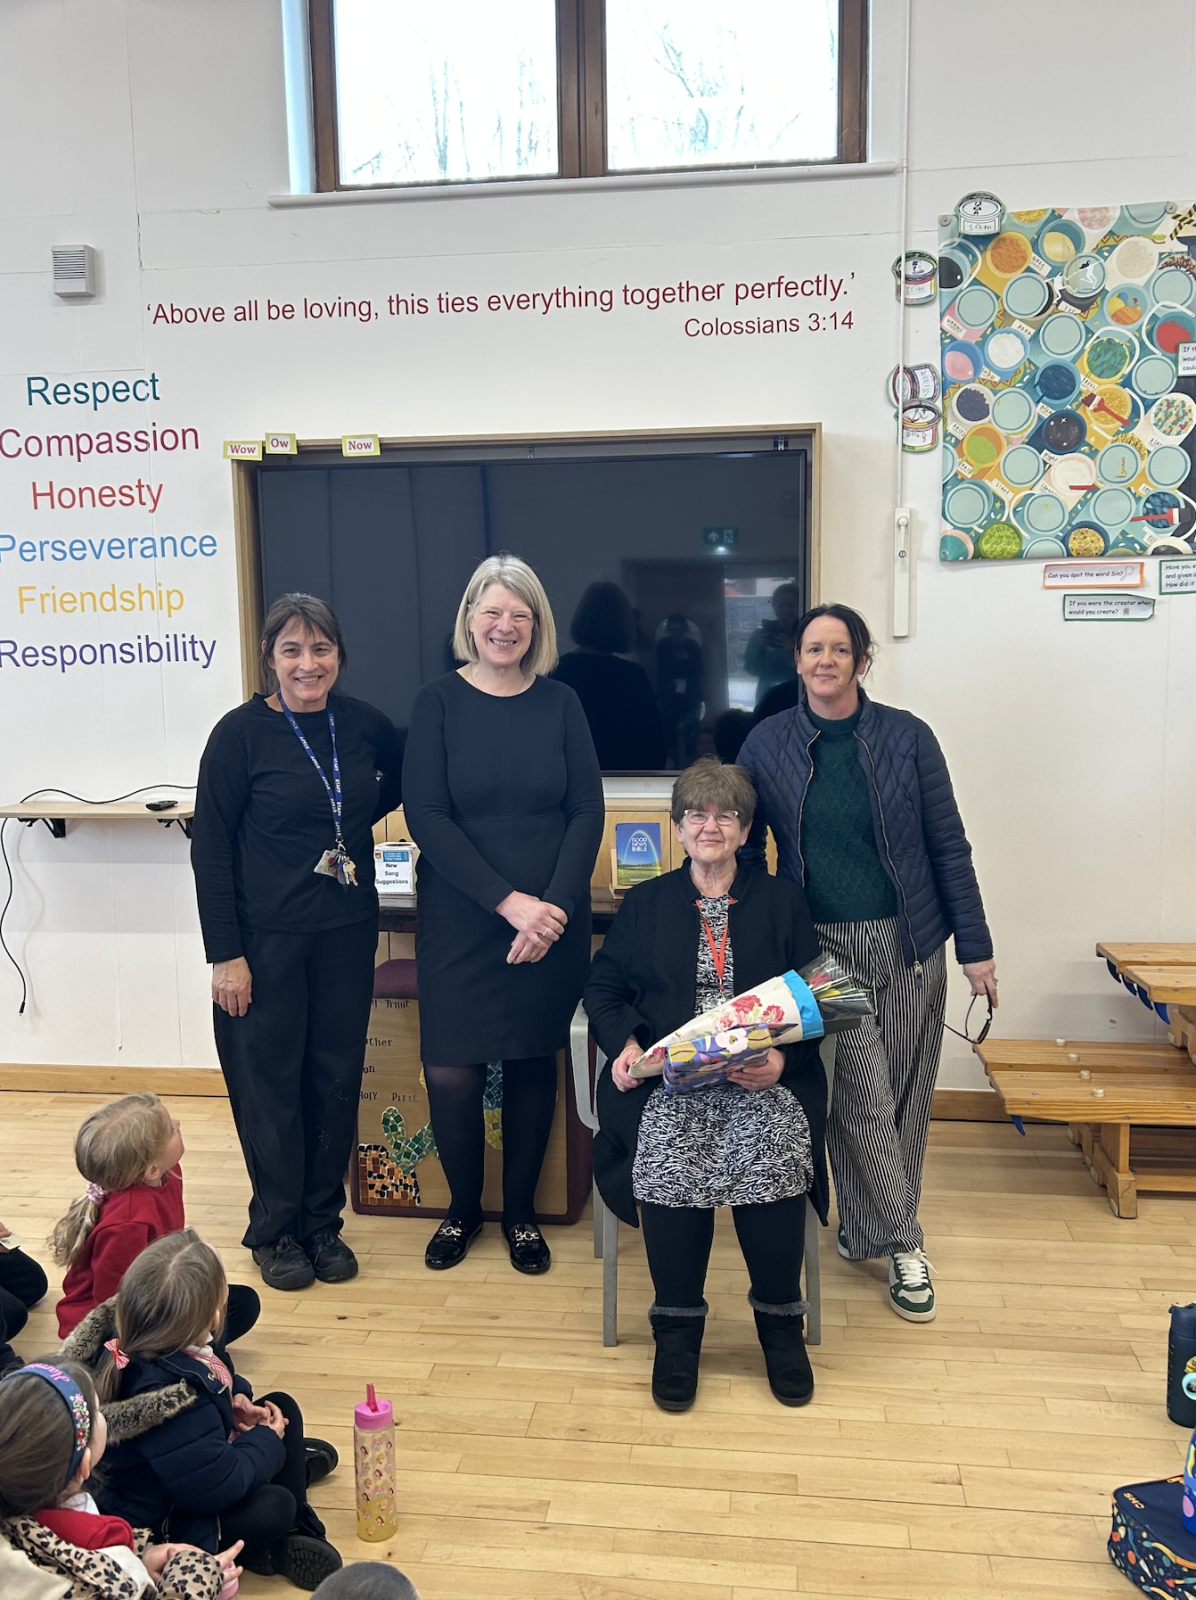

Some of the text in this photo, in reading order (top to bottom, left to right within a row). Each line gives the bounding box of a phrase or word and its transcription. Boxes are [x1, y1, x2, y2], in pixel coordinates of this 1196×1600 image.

[234, 300, 259, 322] all
[267, 299, 295, 320] be
[304, 297, 379, 322] loving,
[388, 293, 429, 315] this
[437, 292, 479, 314] ties
[487, 286, 613, 315] everything
[622, 280, 725, 310] together
[684, 311, 855, 337] Colossians 3:14
[27, 372, 161, 411] Respect
[0, 422, 199, 462] Compassion
[230, 444, 256, 454] Wow
[270, 438, 289, 448] Ow
[348, 441, 372, 451] Now
[32, 478, 163, 513] Honesty
[0, 534, 218, 563] Perseverance
[18, 582, 185, 618] Friendship
[0, 633, 217, 673] Responsibility
